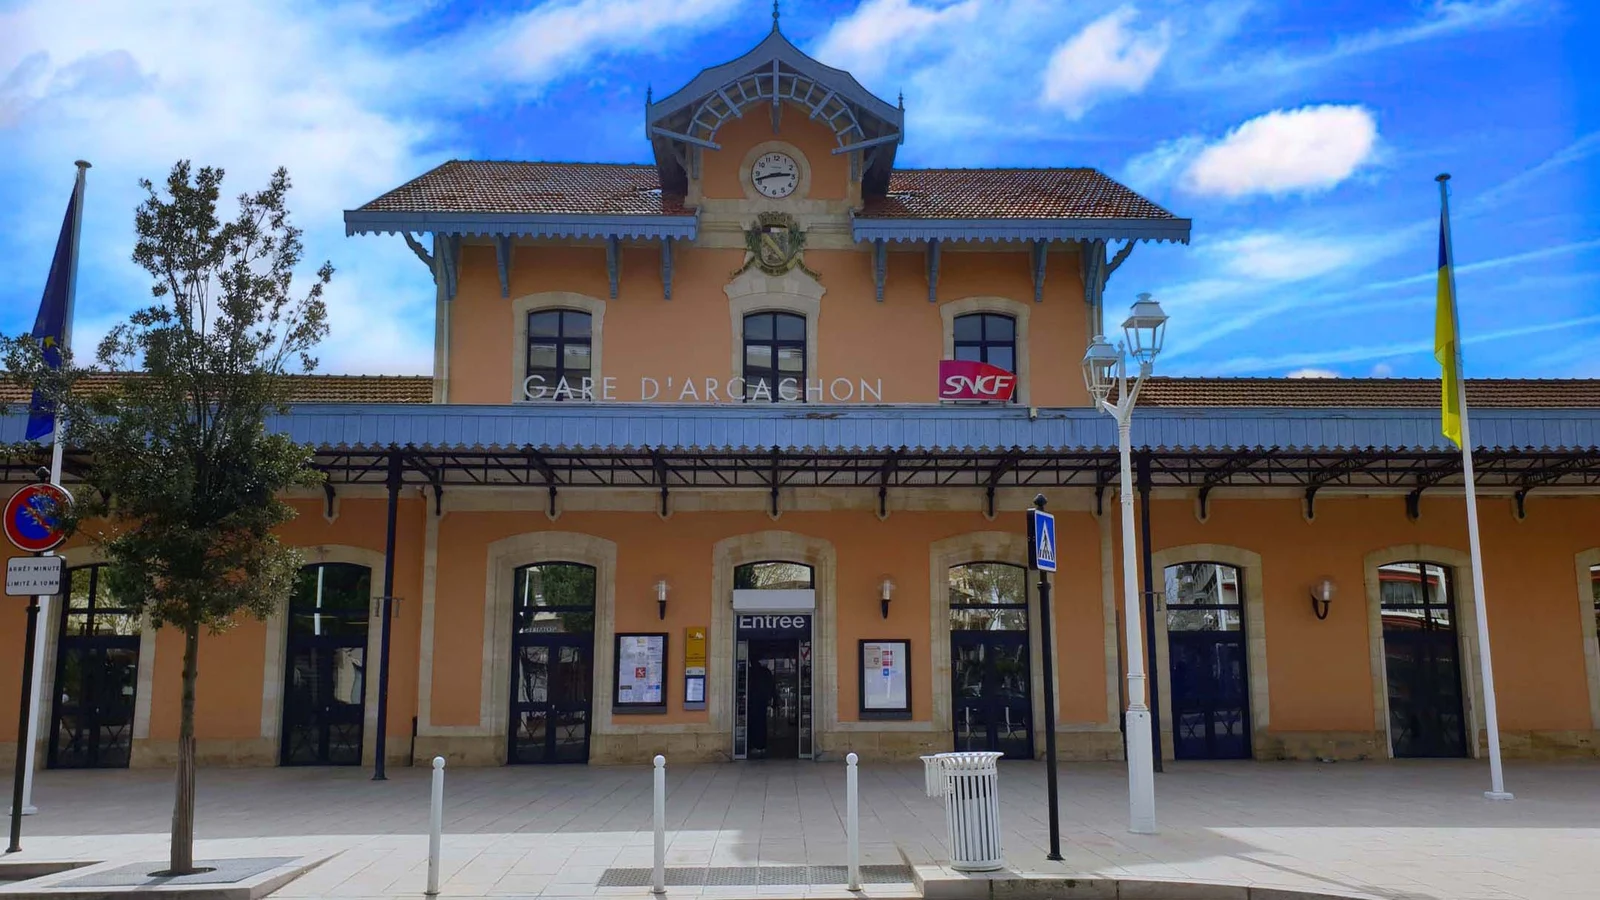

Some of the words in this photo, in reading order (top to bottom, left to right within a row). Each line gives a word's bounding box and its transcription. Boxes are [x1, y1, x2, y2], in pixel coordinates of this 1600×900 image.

[523, 374, 617, 400] GARE
[641, 376, 882, 401] D'ARCACHON
[943, 375, 1013, 395] SNCF
